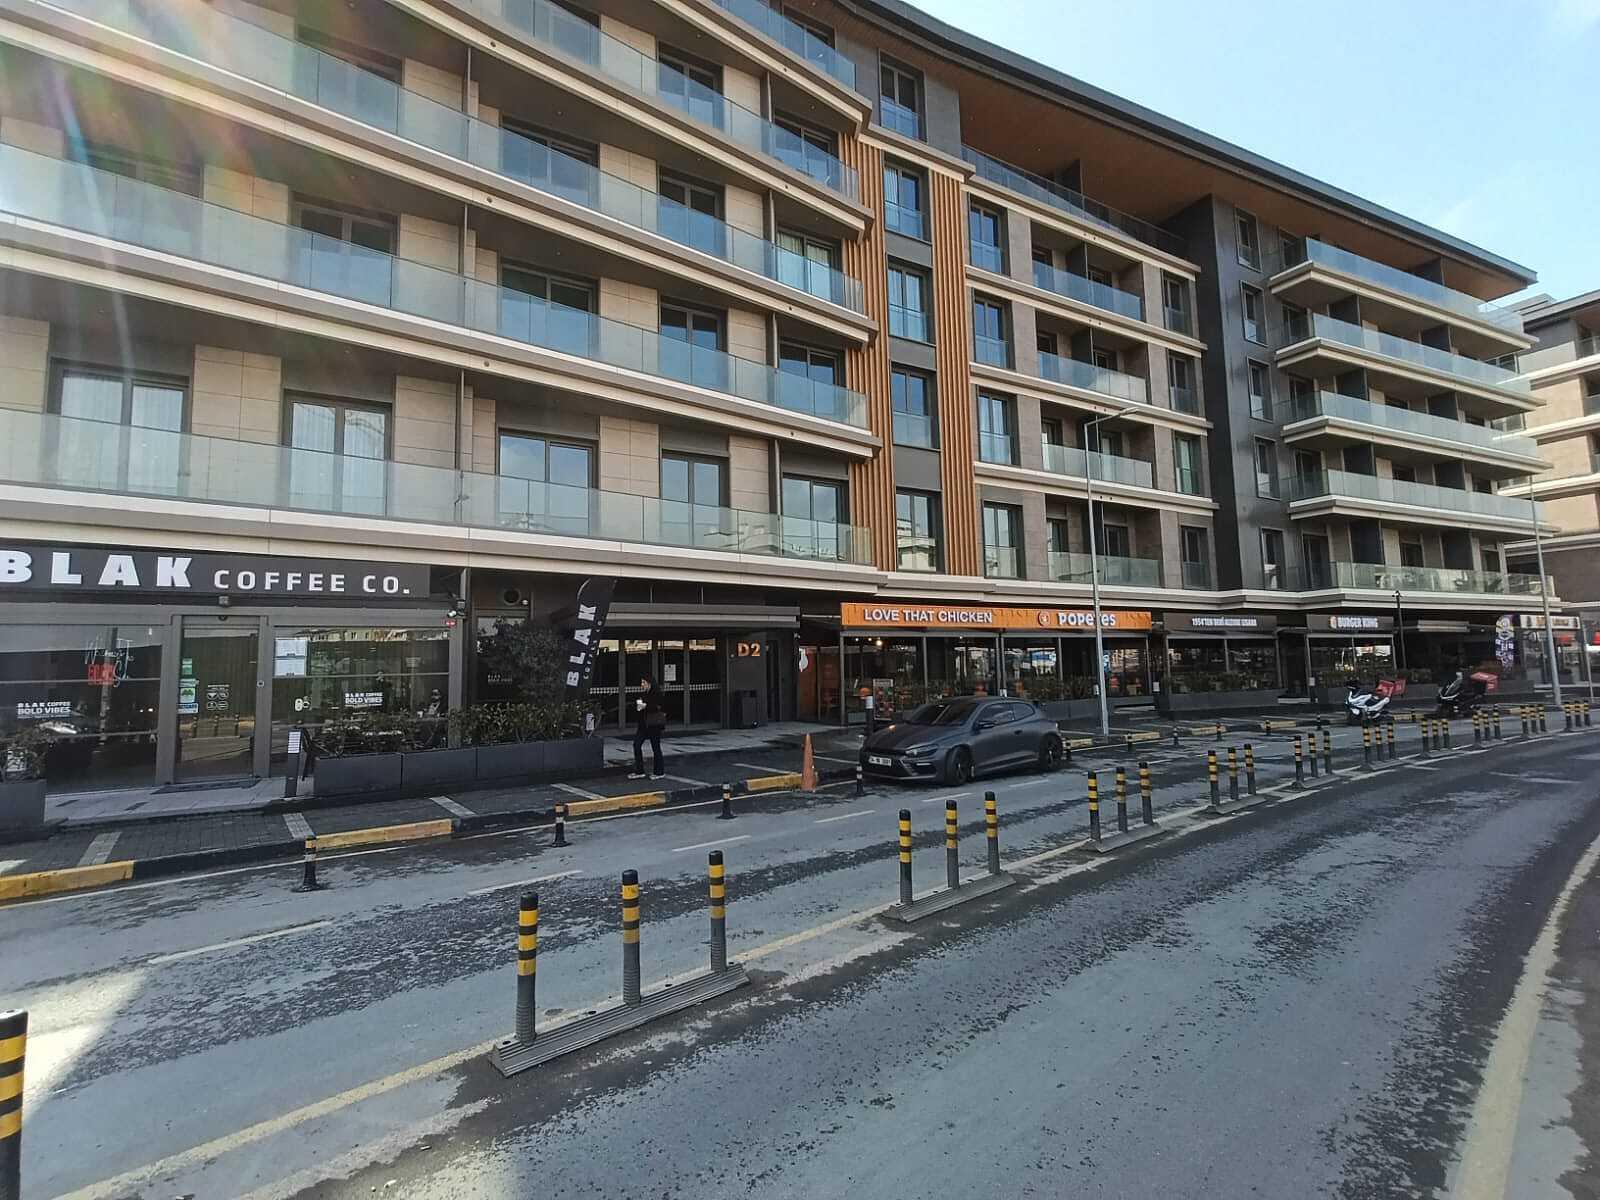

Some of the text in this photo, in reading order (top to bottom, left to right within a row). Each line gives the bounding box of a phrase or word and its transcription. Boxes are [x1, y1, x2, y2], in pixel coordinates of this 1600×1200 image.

[0, 550, 410, 594] BLAK COFFEE CO.
[864, 608, 993, 623] LOVE THAT CHICKEN
[566, 604, 597, 687] BLAK
[737, 642, 761, 657] D2
[17, 707, 43, 715] BOLD
